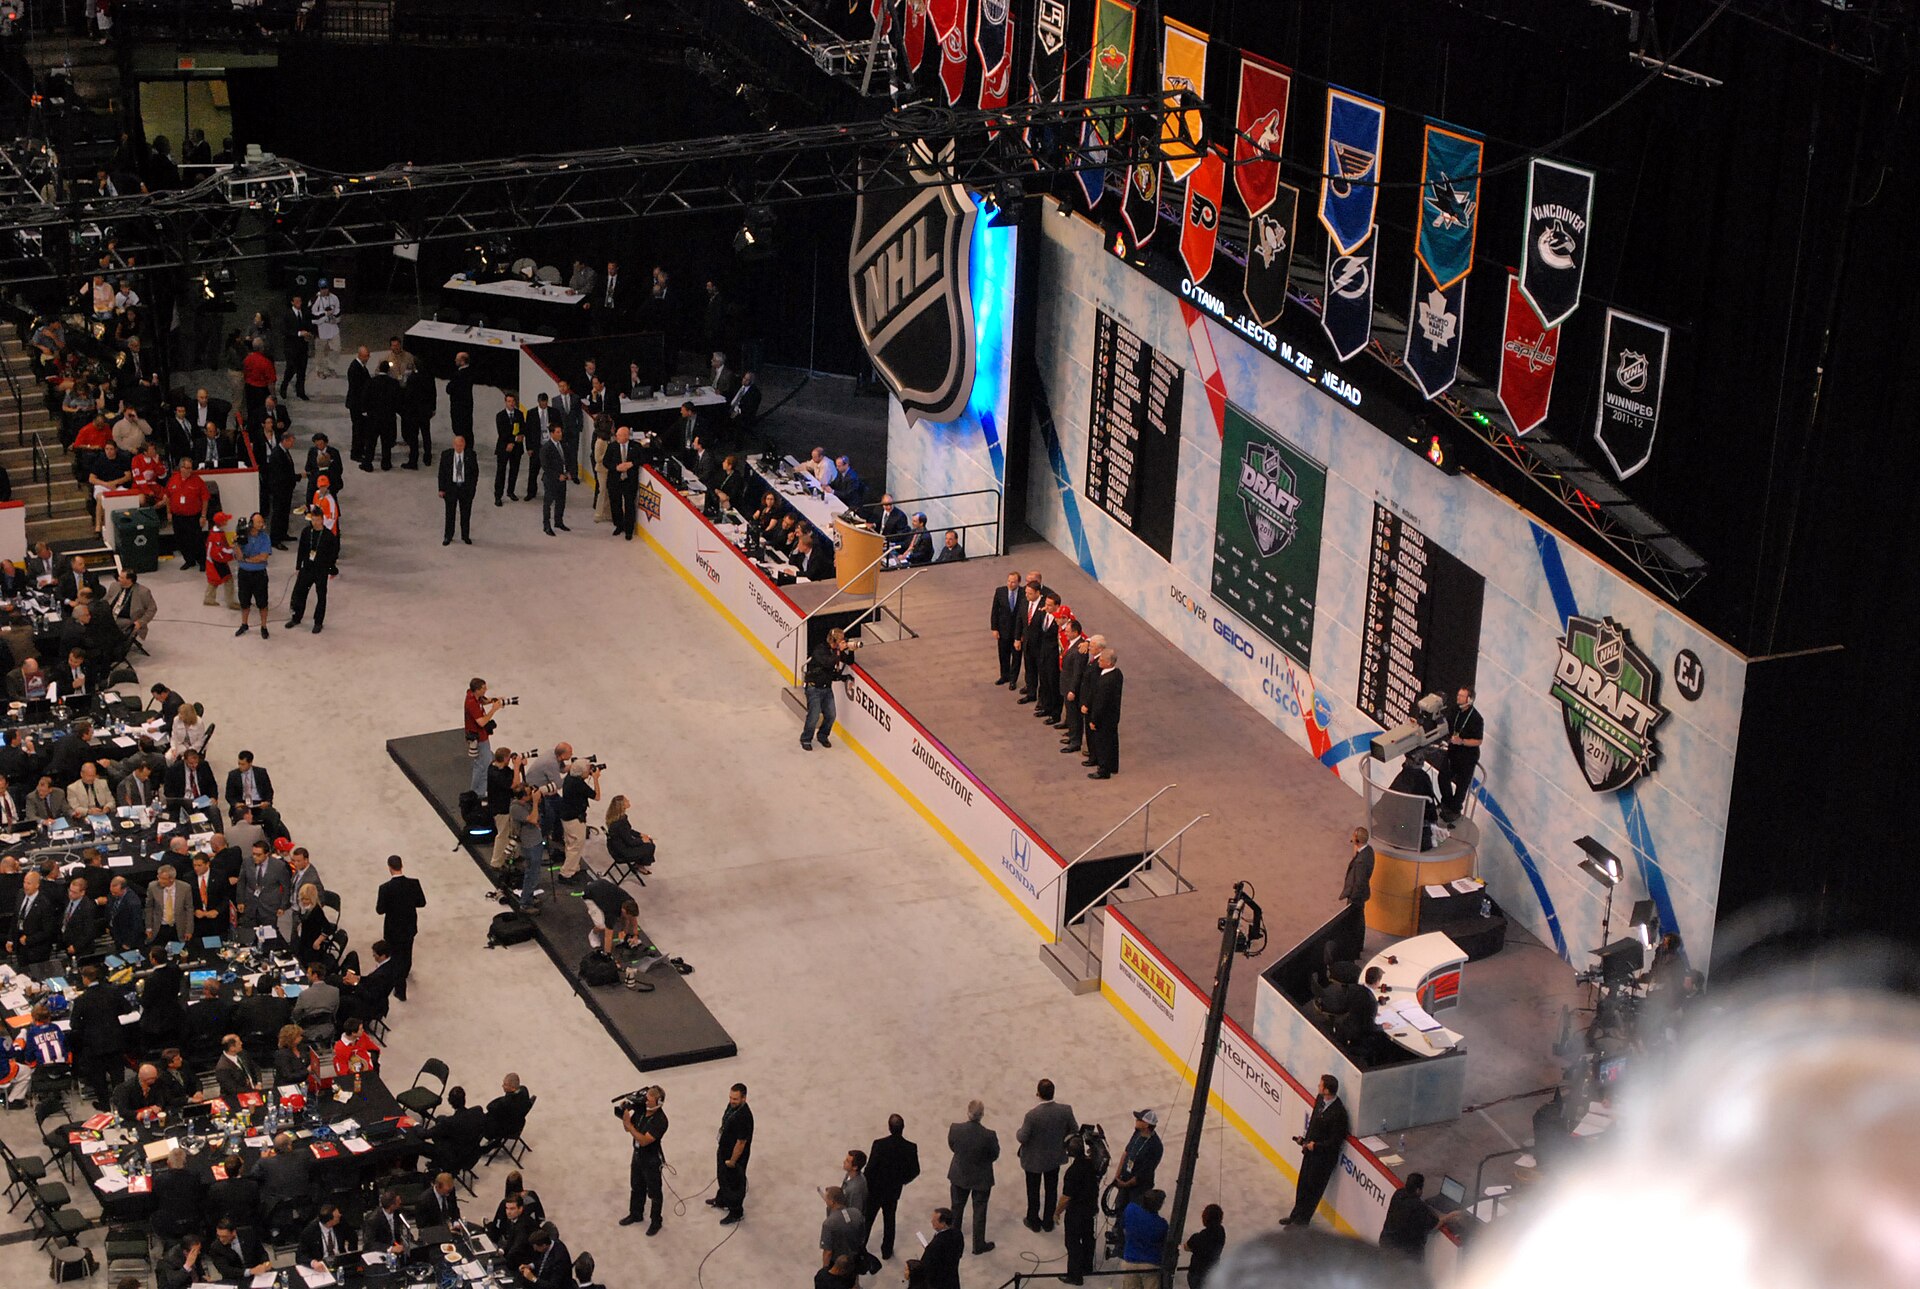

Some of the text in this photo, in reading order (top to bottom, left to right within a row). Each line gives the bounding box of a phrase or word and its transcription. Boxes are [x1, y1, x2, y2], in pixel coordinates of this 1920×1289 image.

[1042, 2, 1062, 27] LA
[1532, 204, 1586, 234] VANCOUVER
[863, 216, 940, 333] NHL
[1426, 311, 1449, 327] TORONTO
[1280, 342, 1294, 364] M.
[1623, 364, 1643, 381] NHL
[1606, 391, 1654, 417] WINNIPEG
[1612, 410, 1644, 428] 2011-12
[1241, 462, 1300, 517] DRAFT
[1401, 522, 1424, 548] BUFFALO
[695, 552, 721, 584] verizon
[1398, 550, 1422, 576] CHICAGO
[1170, 585, 1207, 623] DISCOVER
[1213, 617, 1254, 660] GEICO
[1600, 643, 1620, 663] NHL
[1676, 653, 1702, 693] EJ
[1262, 678, 1300, 717] CISCO
[1556, 647, 1657, 735] DRAFT
[855, 686, 891, 732] SERIES
[1385, 699, 1407, 725] VANCOU
[1574, 702, 1629, 746] MINNESOTA
[1586, 743, 1610, 766] 2011
[911, 737, 973, 807] BRIDGESTONE
[1001, 855, 1036, 898] HONDA
[1124, 943, 1172, 1000] PANINI
[38, 1040, 65, 1065] 11
[1218, 1037, 1281, 1103] nterprise
